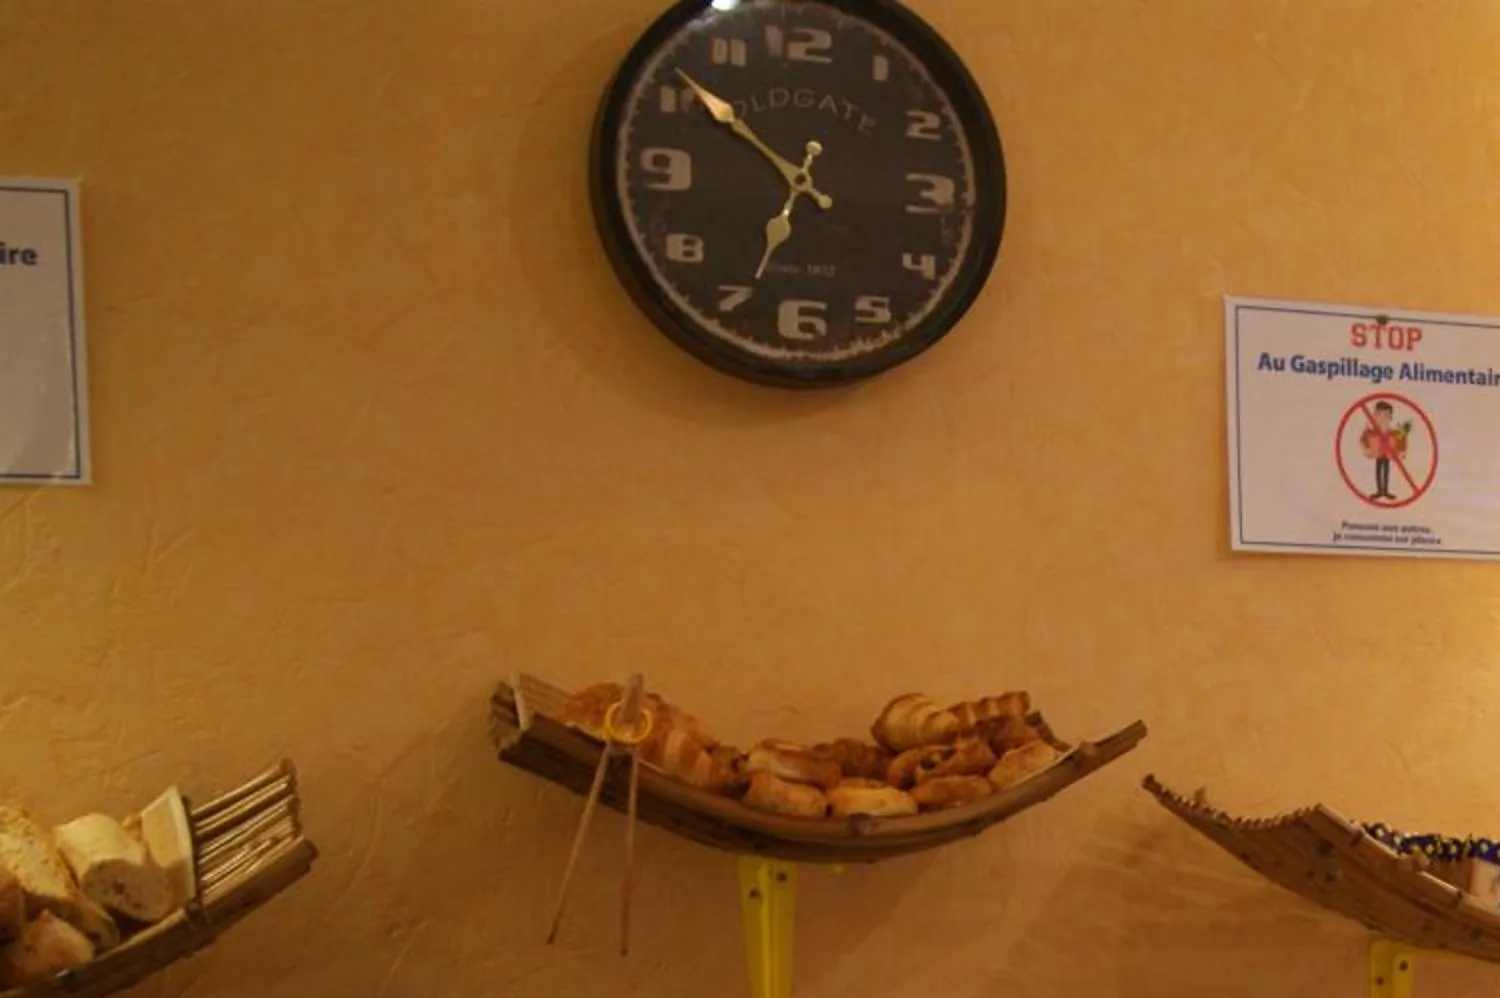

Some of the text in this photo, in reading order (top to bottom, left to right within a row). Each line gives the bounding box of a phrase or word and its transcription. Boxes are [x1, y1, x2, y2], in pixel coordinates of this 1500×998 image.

[764, 25, 833, 64] 12
[905, 110, 941, 140] 2
[639, 147, 692, 191] 9
[905, 173, 955, 214] 3
[665, 233, 704, 263] 8
[902, 253, 935, 280] 4
[717, 285, 752, 312] 7
[854, 297, 892, 323] 5
[777, 300, 828, 341] 6
[1350, 321, 1424, 351] STOP
[1257, 352, 1286, 372] Au
[1290, 354, 1394, 384] Gaspillage
